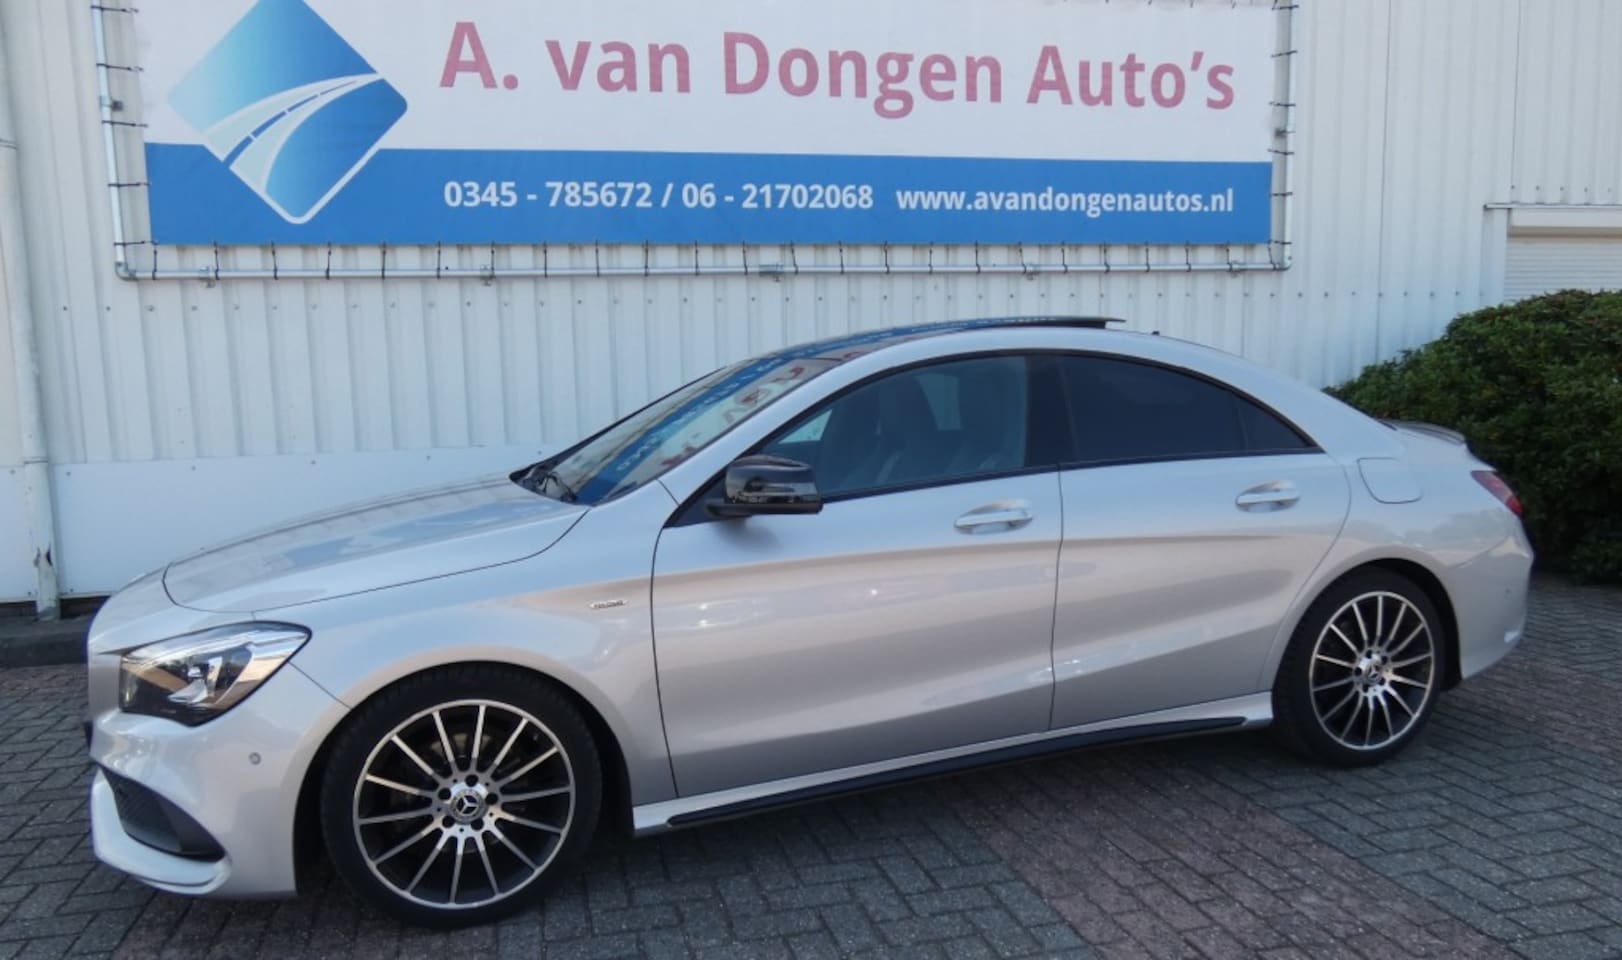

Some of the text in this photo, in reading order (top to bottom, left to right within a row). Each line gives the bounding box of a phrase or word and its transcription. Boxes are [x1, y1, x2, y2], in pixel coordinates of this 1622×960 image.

[440, 21, 1235, 118] A. van Dongen Auto's
[444, 181, 518, 207] 0345
[546, 181, 652, 207] 785672
[661, 183, 673, 208] /
[682, 183, 716, 208] 06
[742, 183, 873, 209] 21702068
[896, 186, 1234, 218] www.avandongenautos.nl
